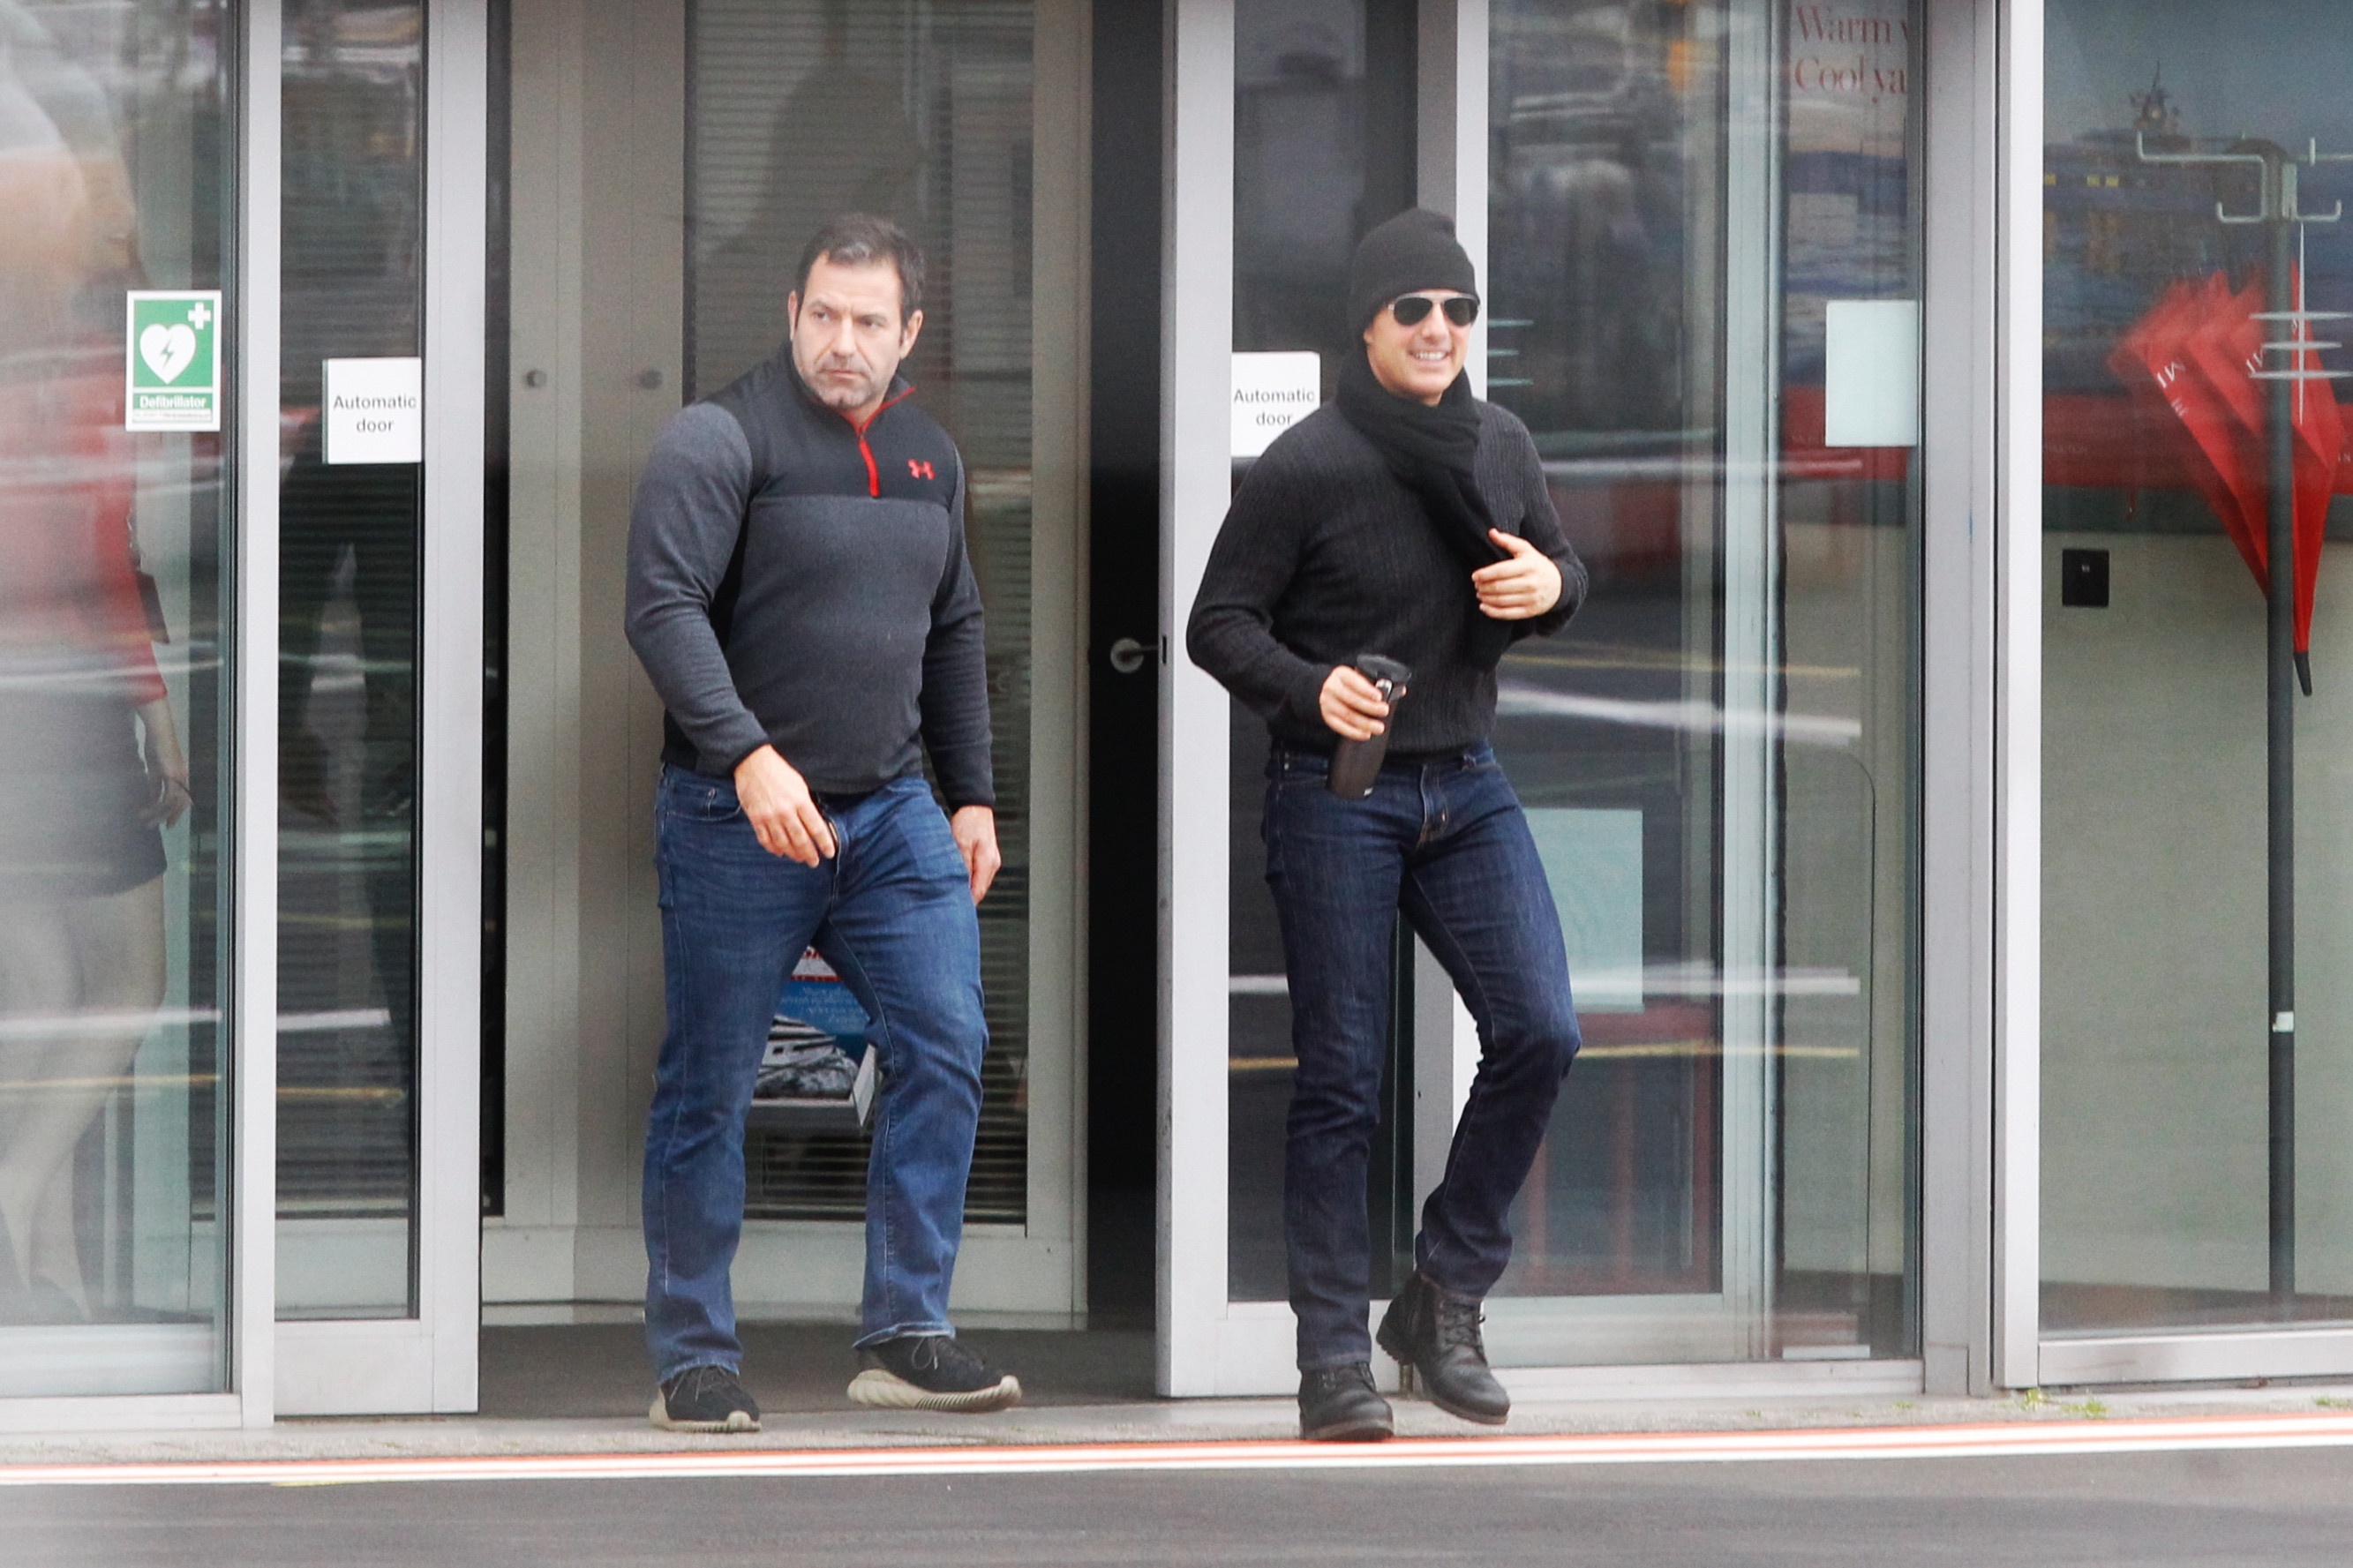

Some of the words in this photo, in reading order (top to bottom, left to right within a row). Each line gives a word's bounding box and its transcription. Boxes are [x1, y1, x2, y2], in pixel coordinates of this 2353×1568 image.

[1796, 5, 1891, 43] Warm
[1794, 55, 1865, 93] Cool
[139, 394, 207, 409] Defibrillator
[334, 394, 417, 409] Automatic
[1234, 387, 1315, 403] Automatic
[356, 417, 395, 433] door
[1256, 411, 1293, 426] door
